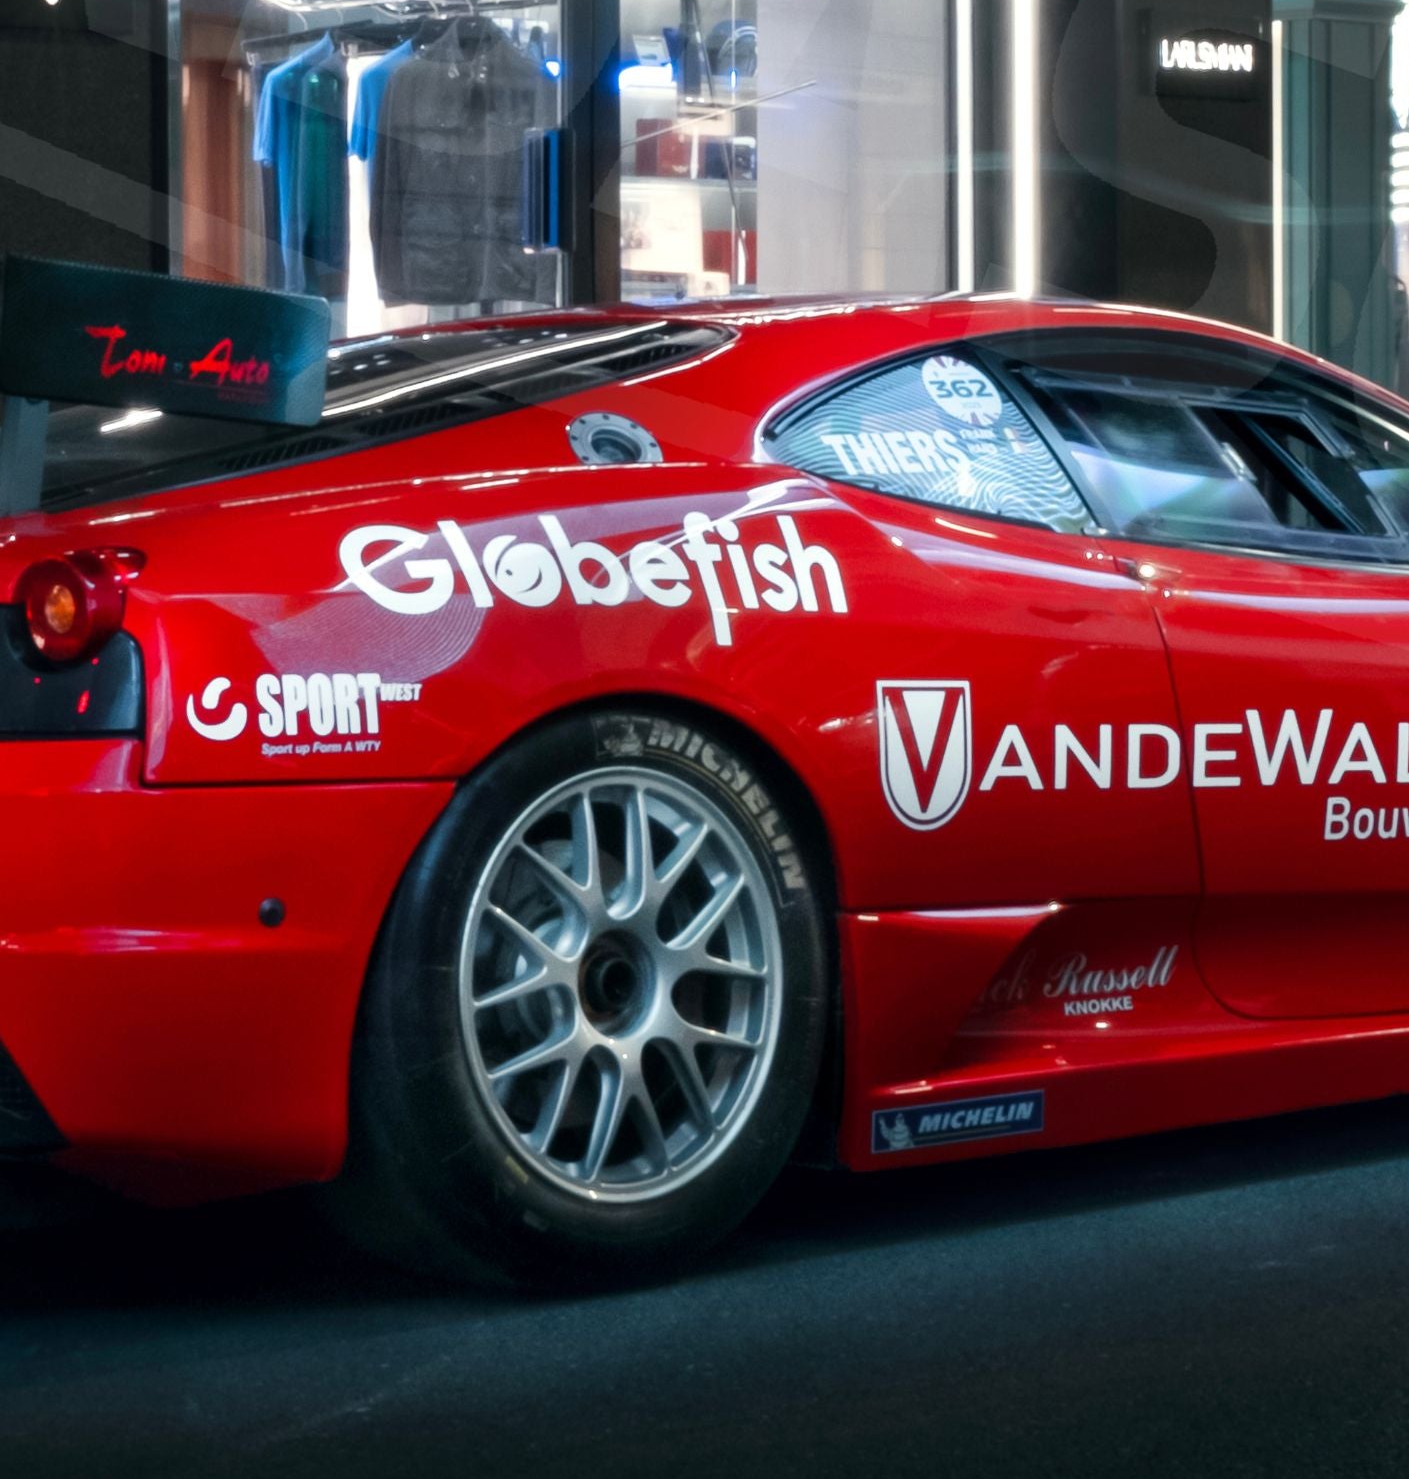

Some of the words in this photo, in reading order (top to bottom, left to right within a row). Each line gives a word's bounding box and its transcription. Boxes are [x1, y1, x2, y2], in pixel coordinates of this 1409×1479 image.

[929, 379, 994, 399] 362
[819, 429, 964, 475] THIERS
[338, 512, 849, 646] Globefish
[256, 672, 382, 738] SPORT
[380, 682, 423, 702] WEST
[261, 742, 293, 758] Sport
[295, 744, 310, 756] up
[1064, 996, 1134, 1016] KNOKKE
[918, 1101, 1034, 1135] MICHELIN
